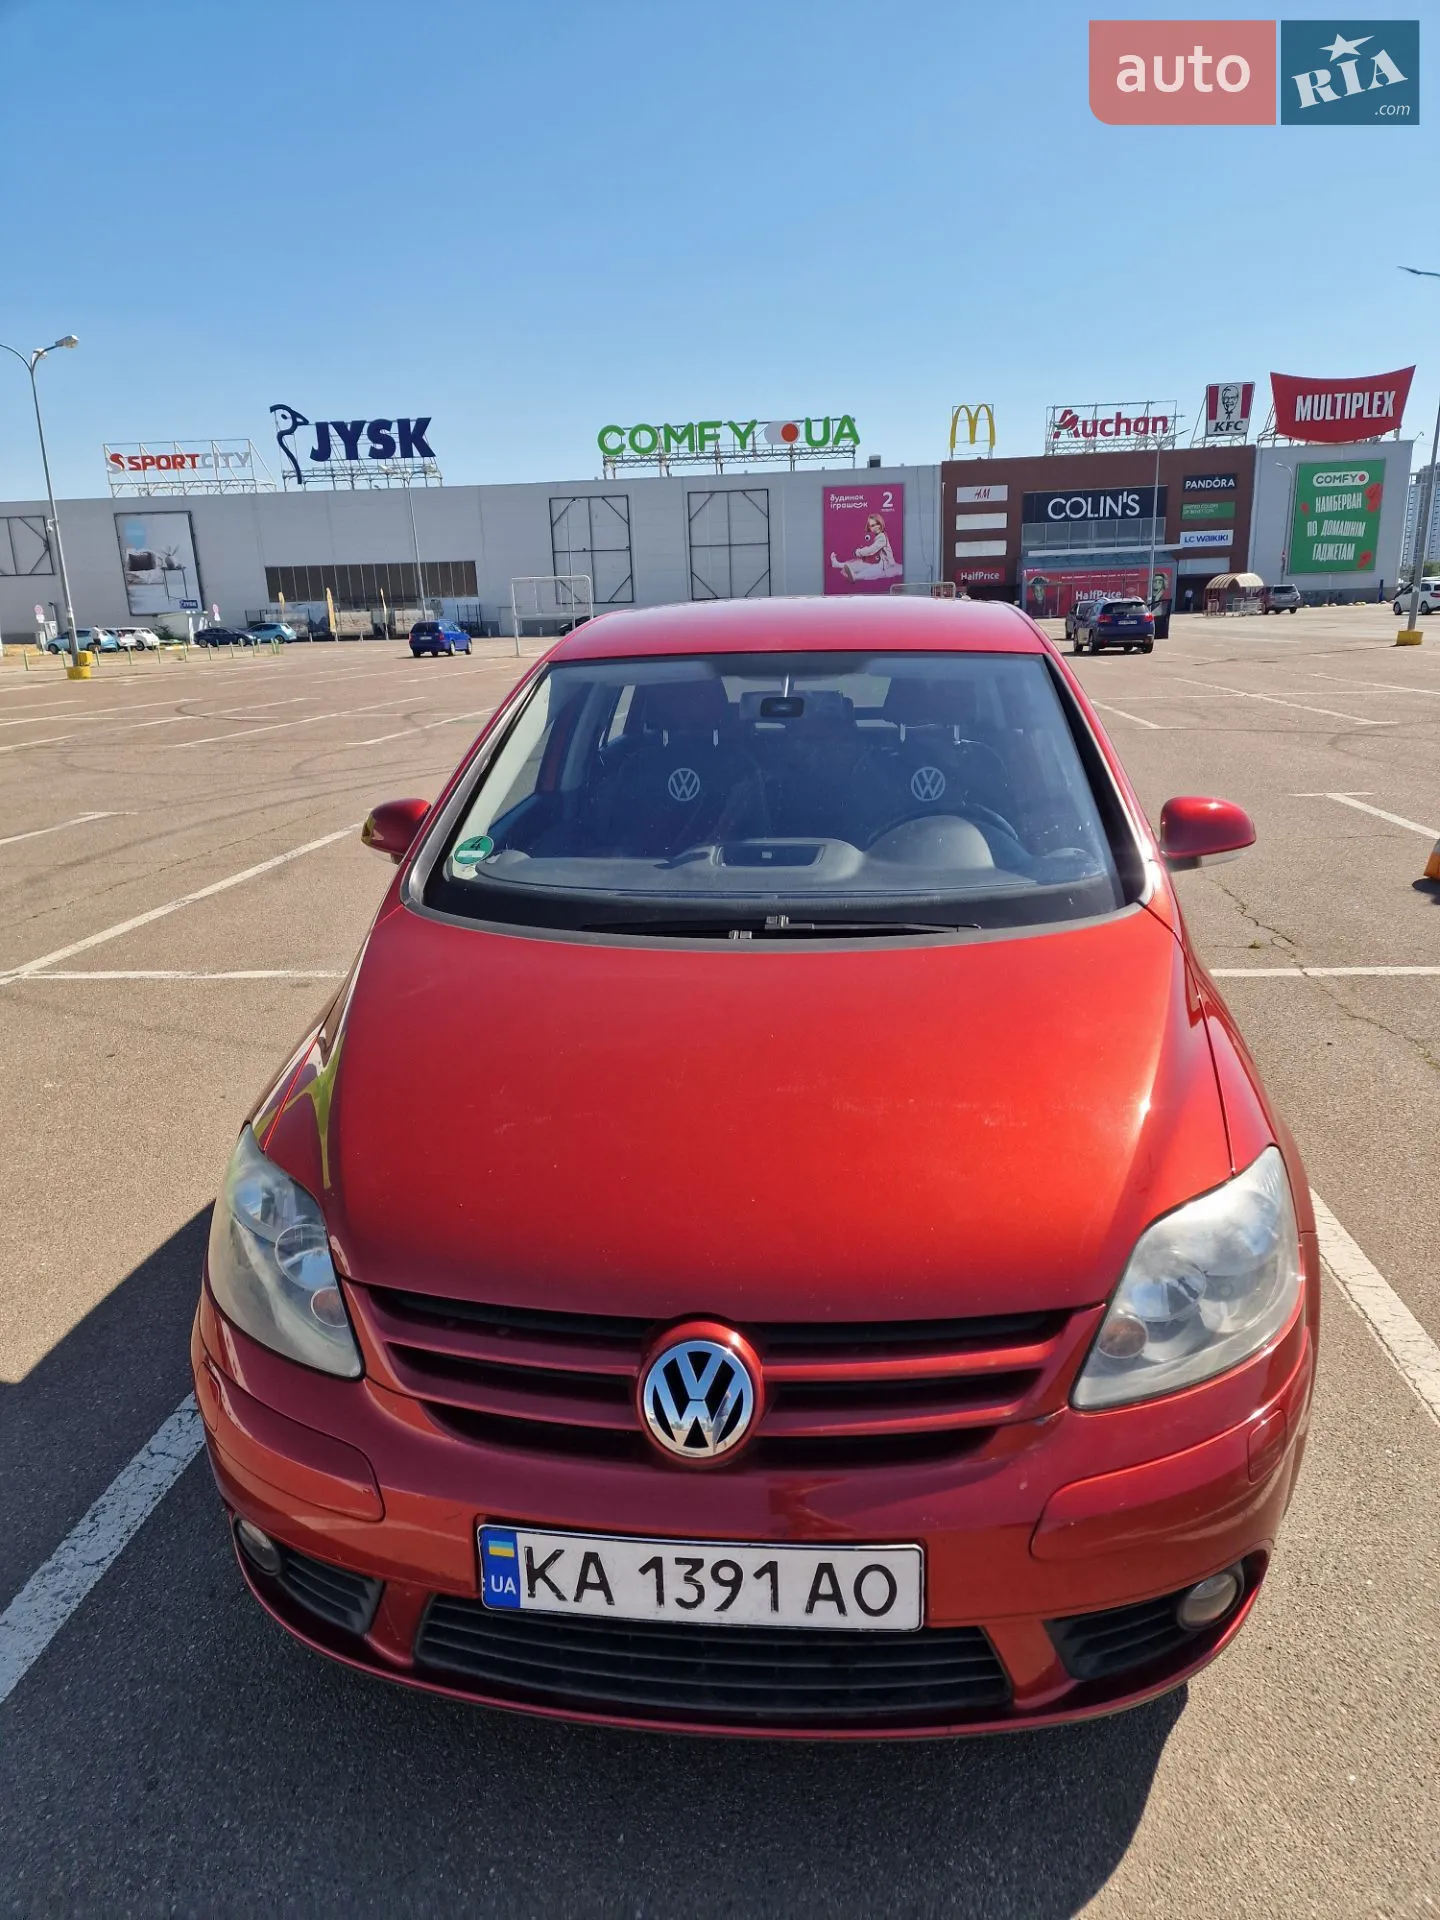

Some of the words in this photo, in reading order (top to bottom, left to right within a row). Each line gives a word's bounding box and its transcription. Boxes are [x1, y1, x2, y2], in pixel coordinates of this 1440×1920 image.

[1295, 390, 1396, 422] MULTIPLEX
[1053, 408, 1169, 439] Auchan
[1214, 420, 1244, 432] KFC
[309, 416, 437, 462] JYSK
[597, 419, 758, 456] COMFY
[804, 414, 861, 448] UA
[1185, 477, 1235, 489] PANDORA
[1316, 474, 1358, 484] COMFY
[882, 491, 894, 508] 2
[1047, 491, 1140, 519] COLIN'S
[1315, 492, 1362, 513] НАМБЕРВАН
[1307, 520, 1318, 537] ПО
[1312, 542, 1356, 562] ГАДЖЕТАМ
[960, 571, 1000, 581] HalfPrice
[1075, 589, 1122, 600] HalfPrice
[491, 1574, 517, 1595] UA
[524, 1546, 615, 1606] KA
[638, 1556, 780, 1613] 1391
[805, 1562, 898, 1618] AO
